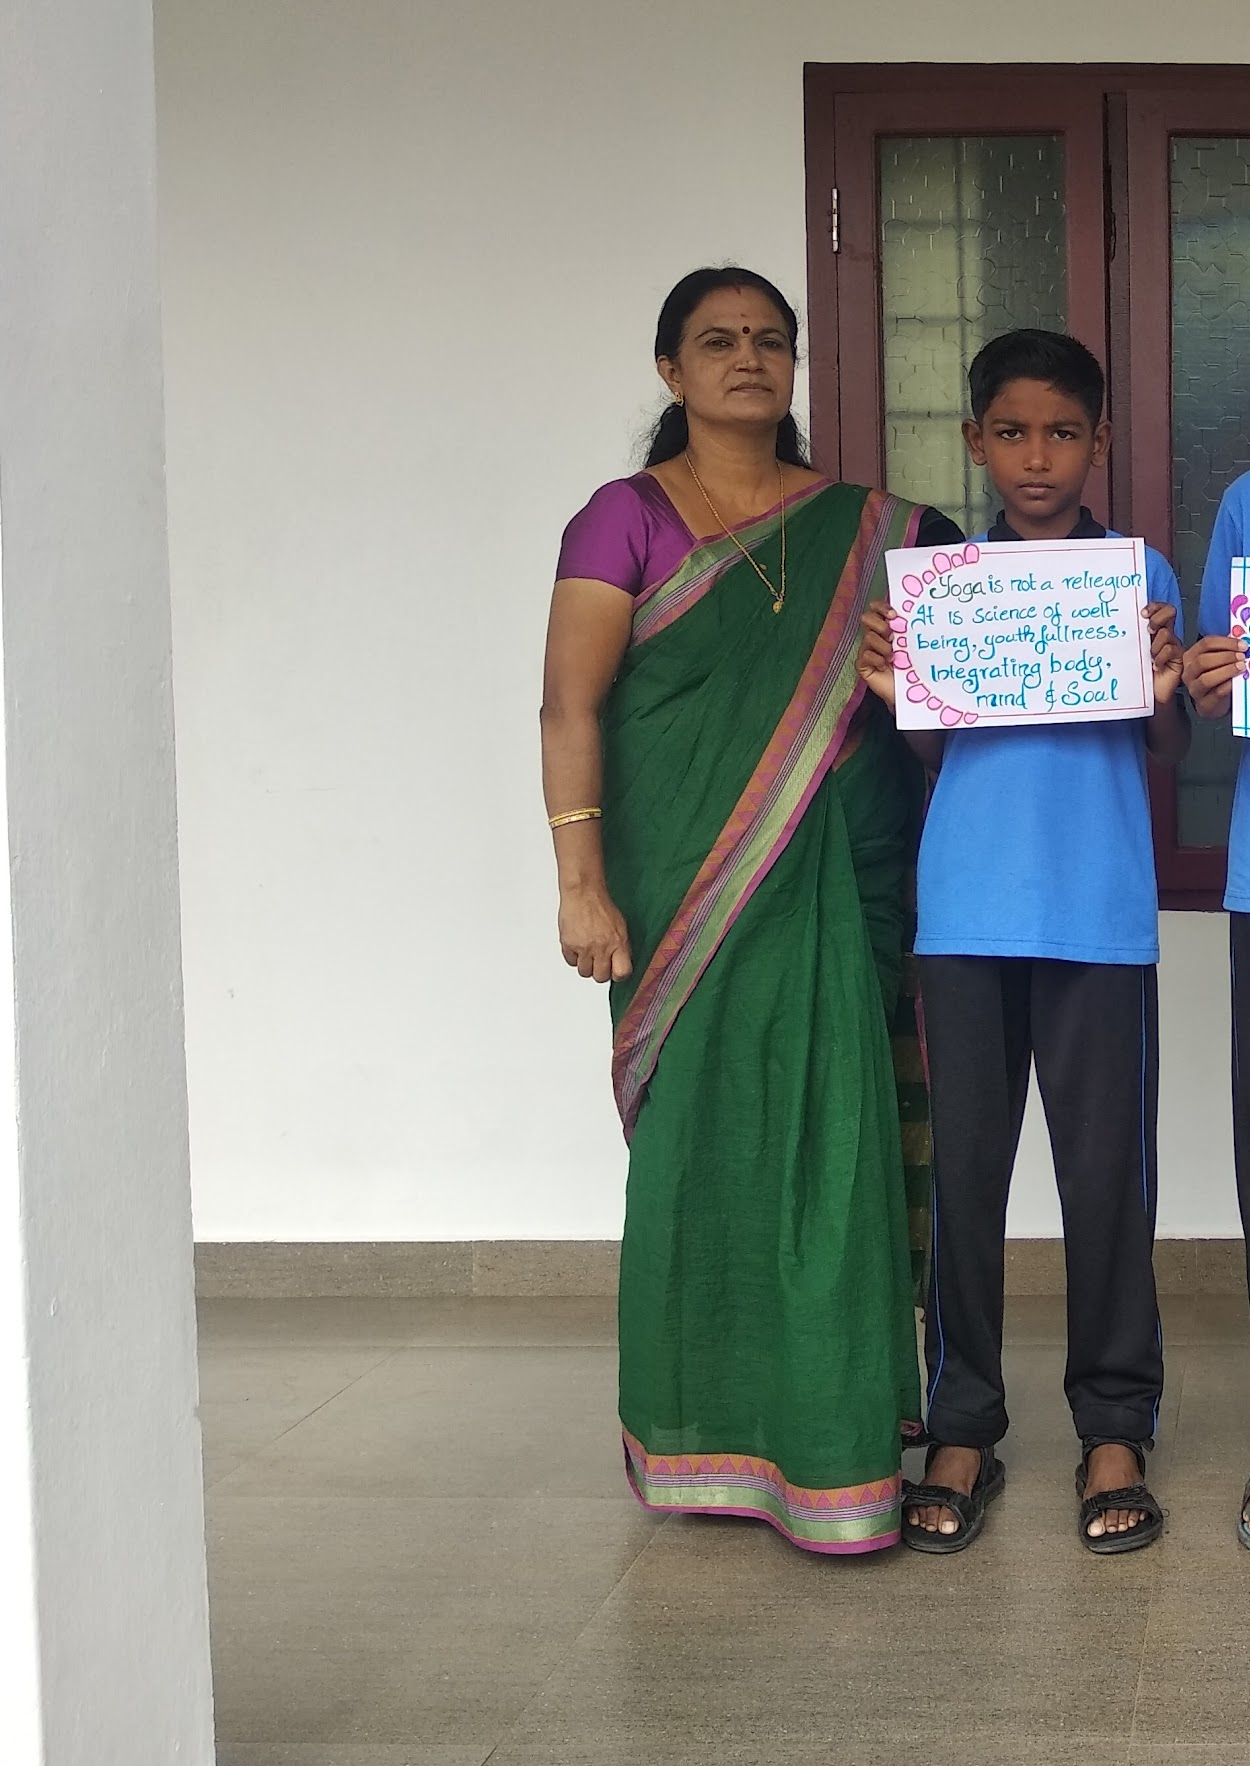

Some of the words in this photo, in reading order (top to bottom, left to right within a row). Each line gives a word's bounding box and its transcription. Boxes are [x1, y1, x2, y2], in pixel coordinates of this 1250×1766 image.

[929, 574, 986, 603] Yoga
[987, 575, 1004, 593] is
[1010, 573, 1036, 591] not
[1040, 579, 1054, 591] a
[1062, 570, 1142, 602] reliegion
[948, 610, 964, 626] is
[972, 605, 1037, 624] science
[1043, 602, 1062, 627] of
[1071, 601, 1120, 620] well-
[917, 633, 977, 662] being,
[930, 656, 1042, 694] Integrating
[976, 685, 1028, 710] mind
[1044, 680, 1057, 713] &
[1061, 679, 1119, 706] Soul
